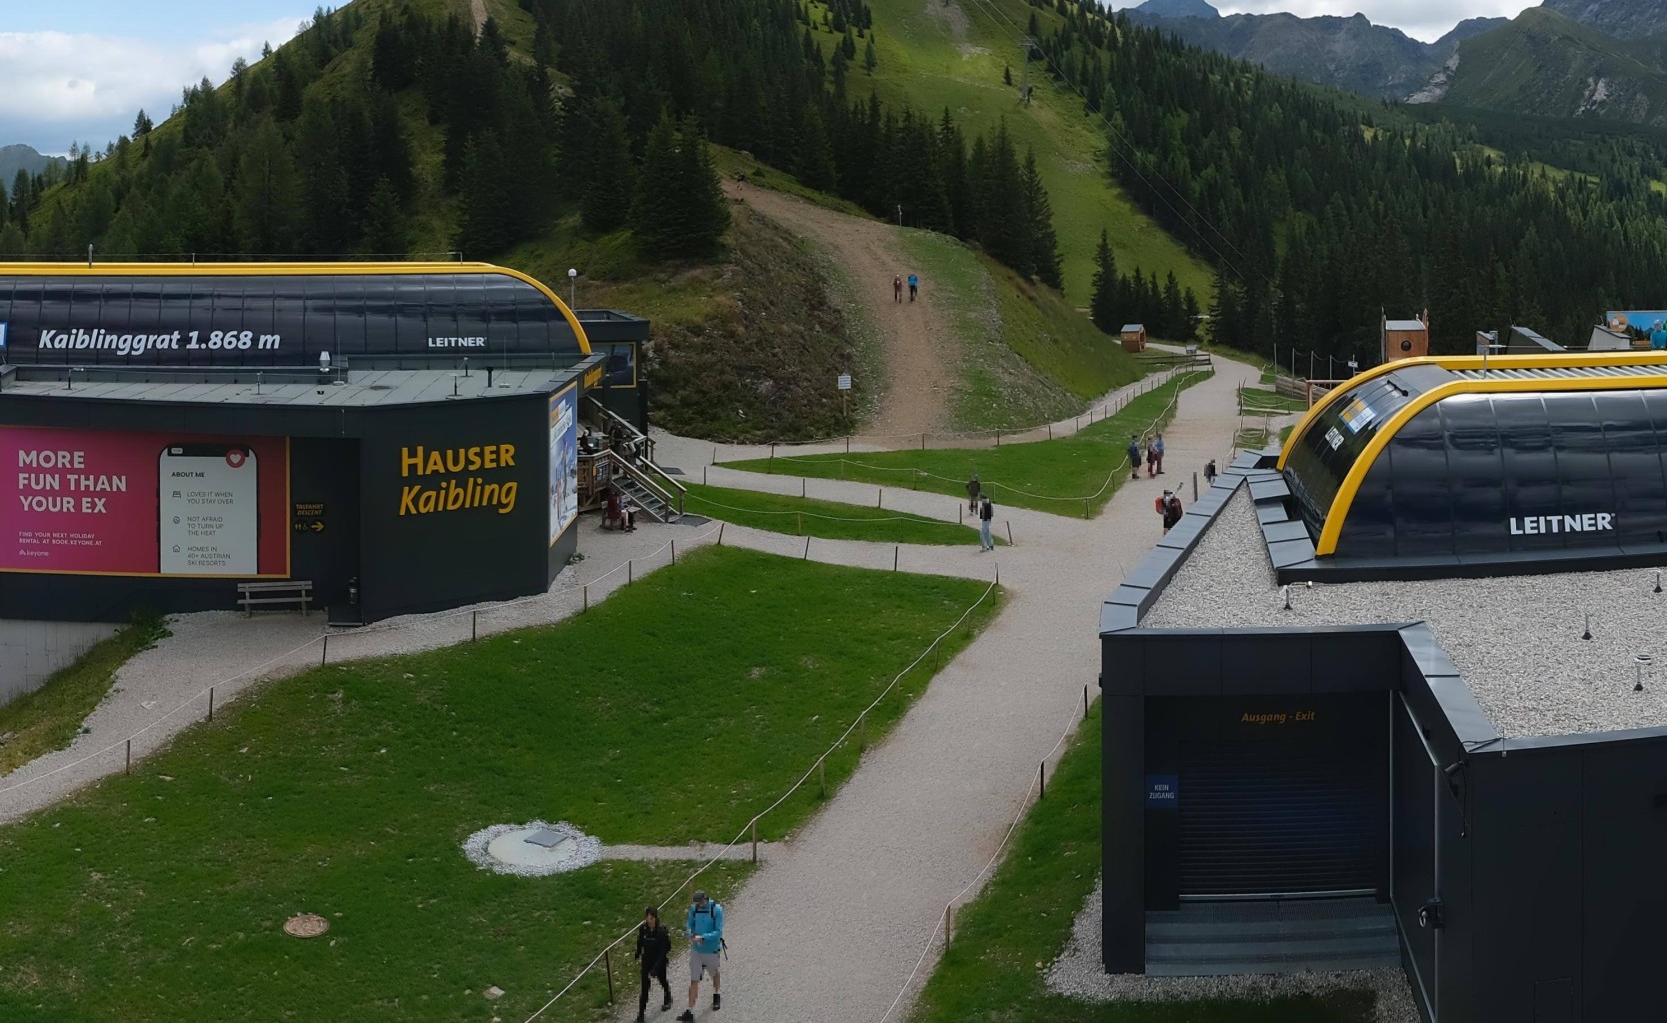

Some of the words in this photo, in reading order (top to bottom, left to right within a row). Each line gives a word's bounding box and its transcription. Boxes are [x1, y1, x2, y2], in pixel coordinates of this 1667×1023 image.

[38, 329, 180, 355] Kaiblinggrat
[185, 330, 253, 350] 1.868
[258, 333, 281, 350] m
[18, 450, 85, 469] MORE
[401, 444, 516, 477] HAUSER
[18, 473, 60, 490] FUN
[66, 474, 127, 492] THAN
[19, 496, 76, 513] YOUR
[81, 497, 107, 514] EX
[399, 478, 518, 516] Kaibling
[1241, 712, 1287, 725] Ausgang
[1295, 710, 1316, 721] Exit
